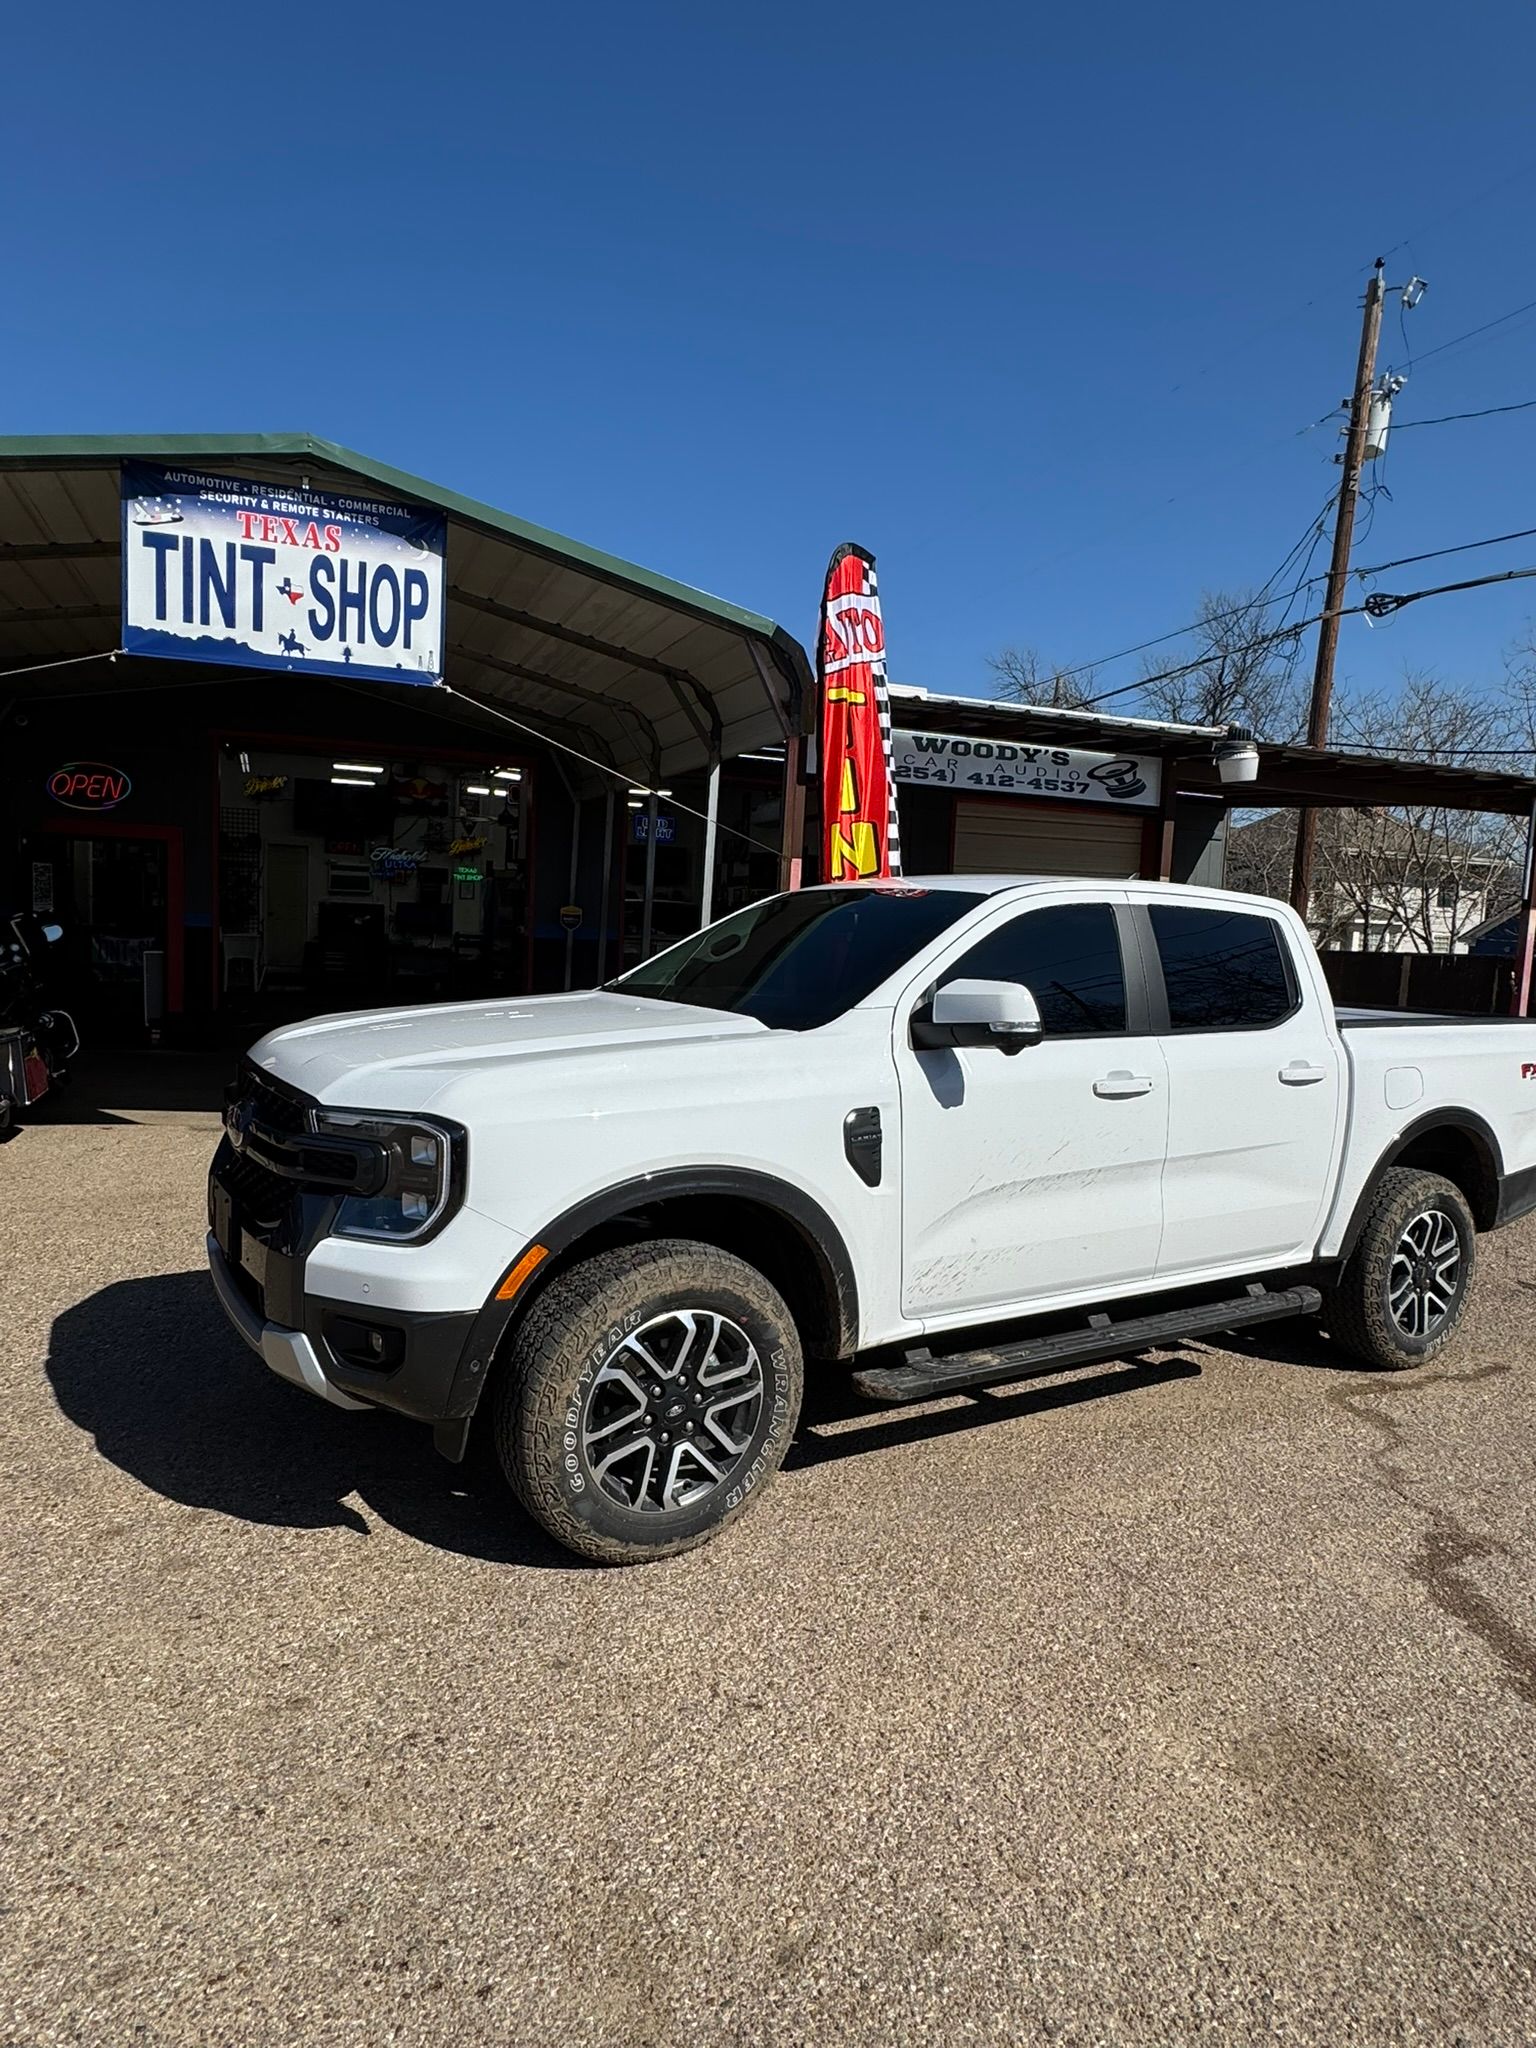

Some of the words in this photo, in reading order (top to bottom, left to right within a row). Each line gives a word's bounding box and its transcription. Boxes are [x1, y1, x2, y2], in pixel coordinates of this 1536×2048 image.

[164, 471, 241, 493] AUTOMOTIVE
[251, 484, 328, 506] RESIDENTIAL
[338, 498, 411, 519] COMMERCIAL
[199, 489, 258, 507] SECURITY
[260, 499, 269, 510] &
[272, 500, 320, 518] REMOTE
[321, 509, 380, 527] STARTERS
[236, 510, 342, 553] TEXAS
[142, 530, 276, 632] TINT
[308, 553, 430, 649] SHOP
[903, 754, 958, 770] CAR
[993, 763, 1080, 781] AUDIO
[912, 736, 1070, 767] WOODY'S
[51, 773, 124, 800] OPEN
[966, 772, 1090, 795] 412-4537
[563, 1309, 643, 1493] GOODYEAR
[725, 1347, 791, 1509] WRANGLER
